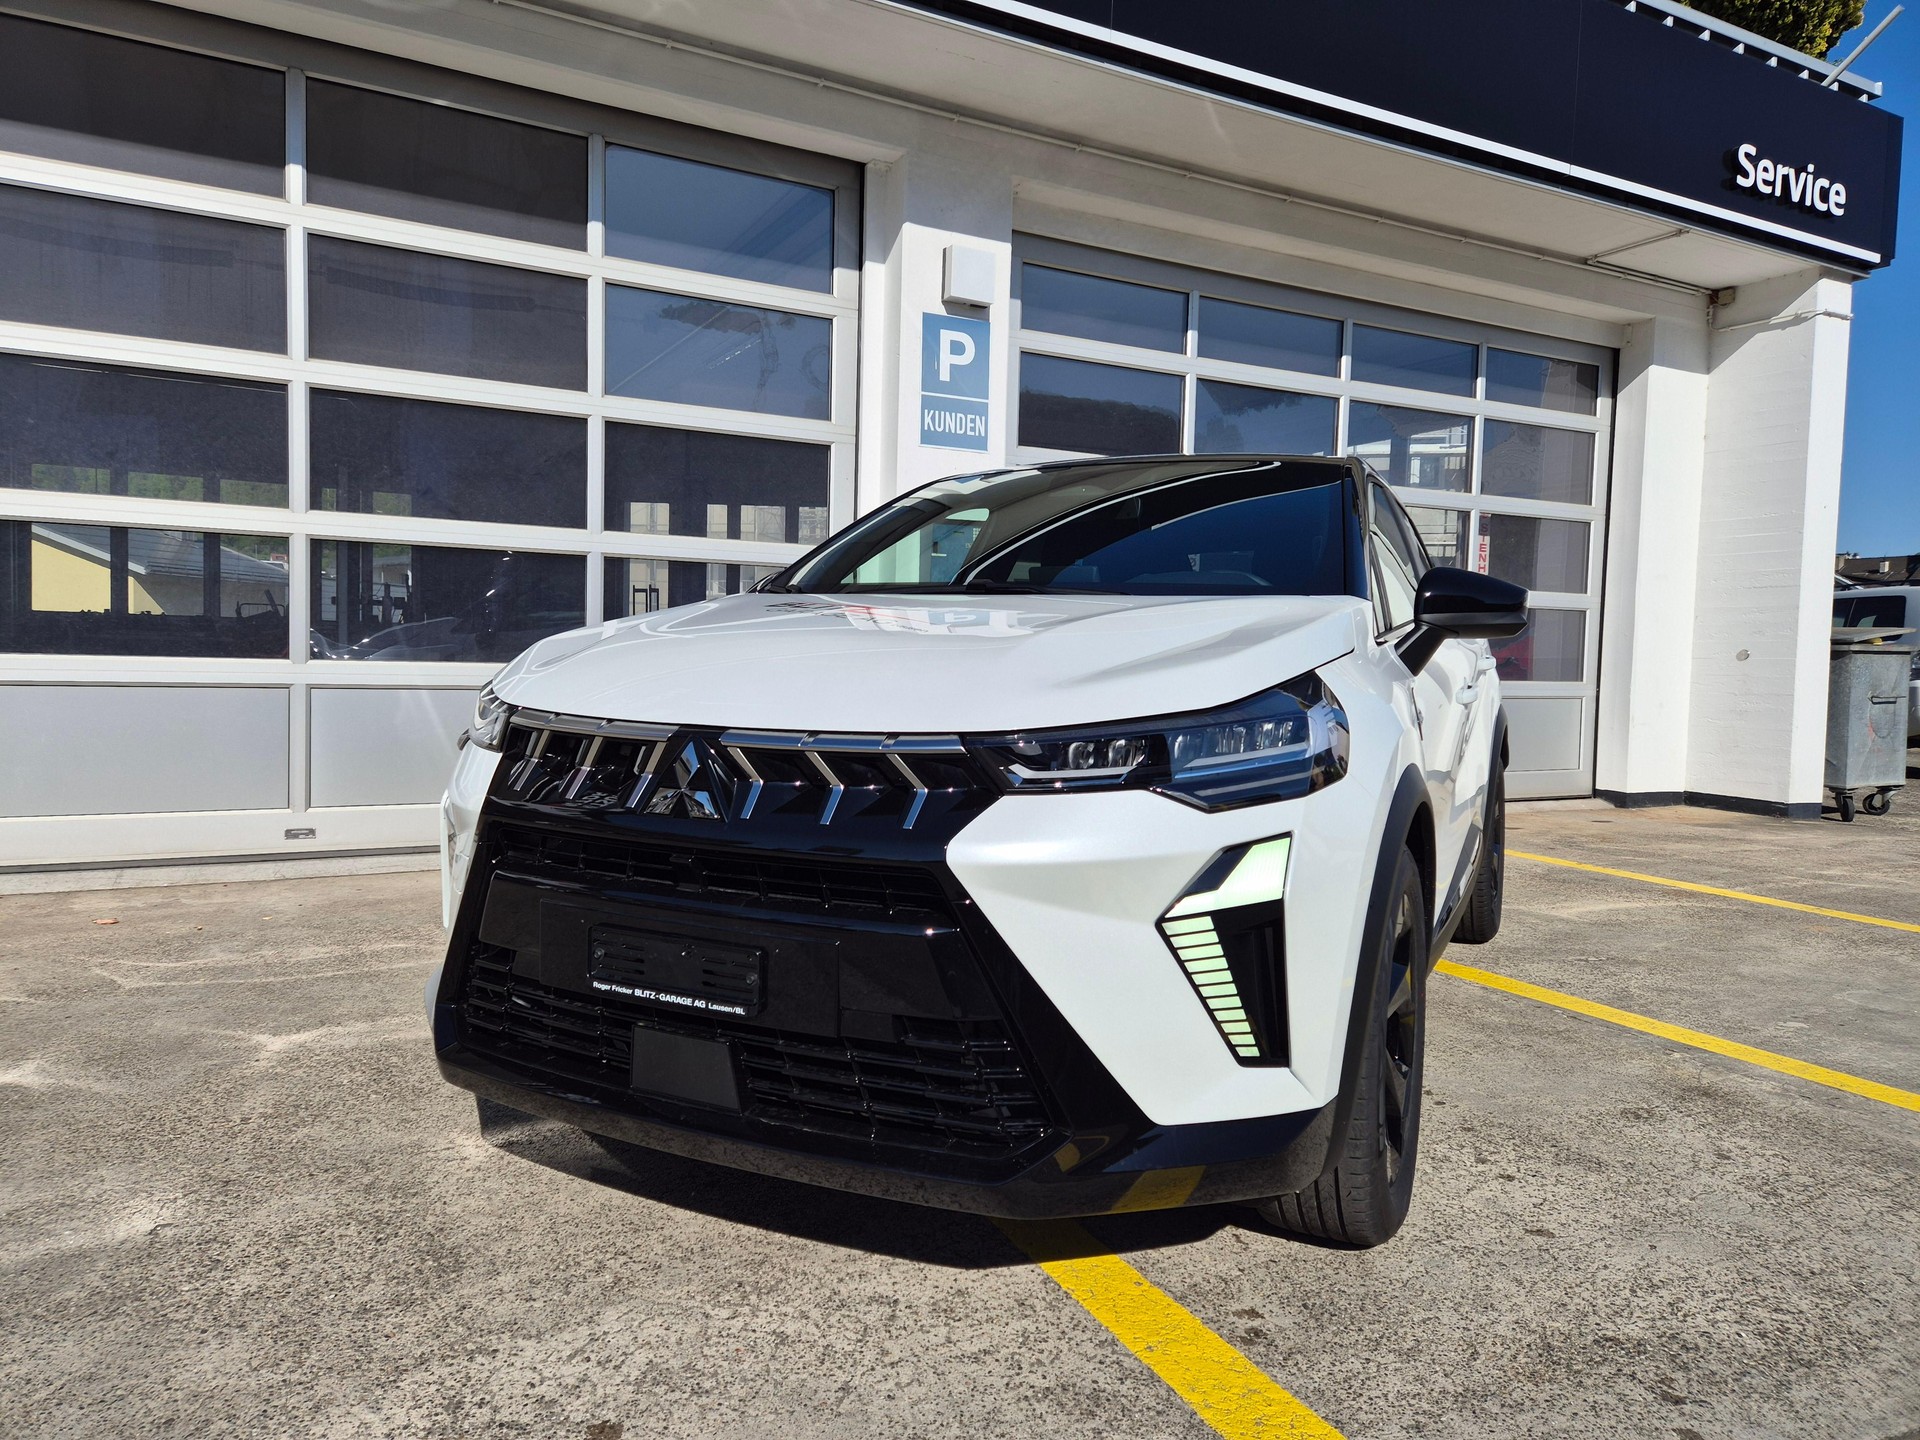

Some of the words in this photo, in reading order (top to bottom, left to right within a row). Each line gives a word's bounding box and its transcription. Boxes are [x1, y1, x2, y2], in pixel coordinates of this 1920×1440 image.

[1736, 143, 1847, 216] Service
[939, 328, 976, 382] P
[924, 409, 986, 437] KUNDEN
[592, 981, 611, 991] Roger
[612, 985, 633, 995] Fricker
[634, 988, 693, 1007] BLITZ-GARAGE
[693, 999, 706, 1009] AG
